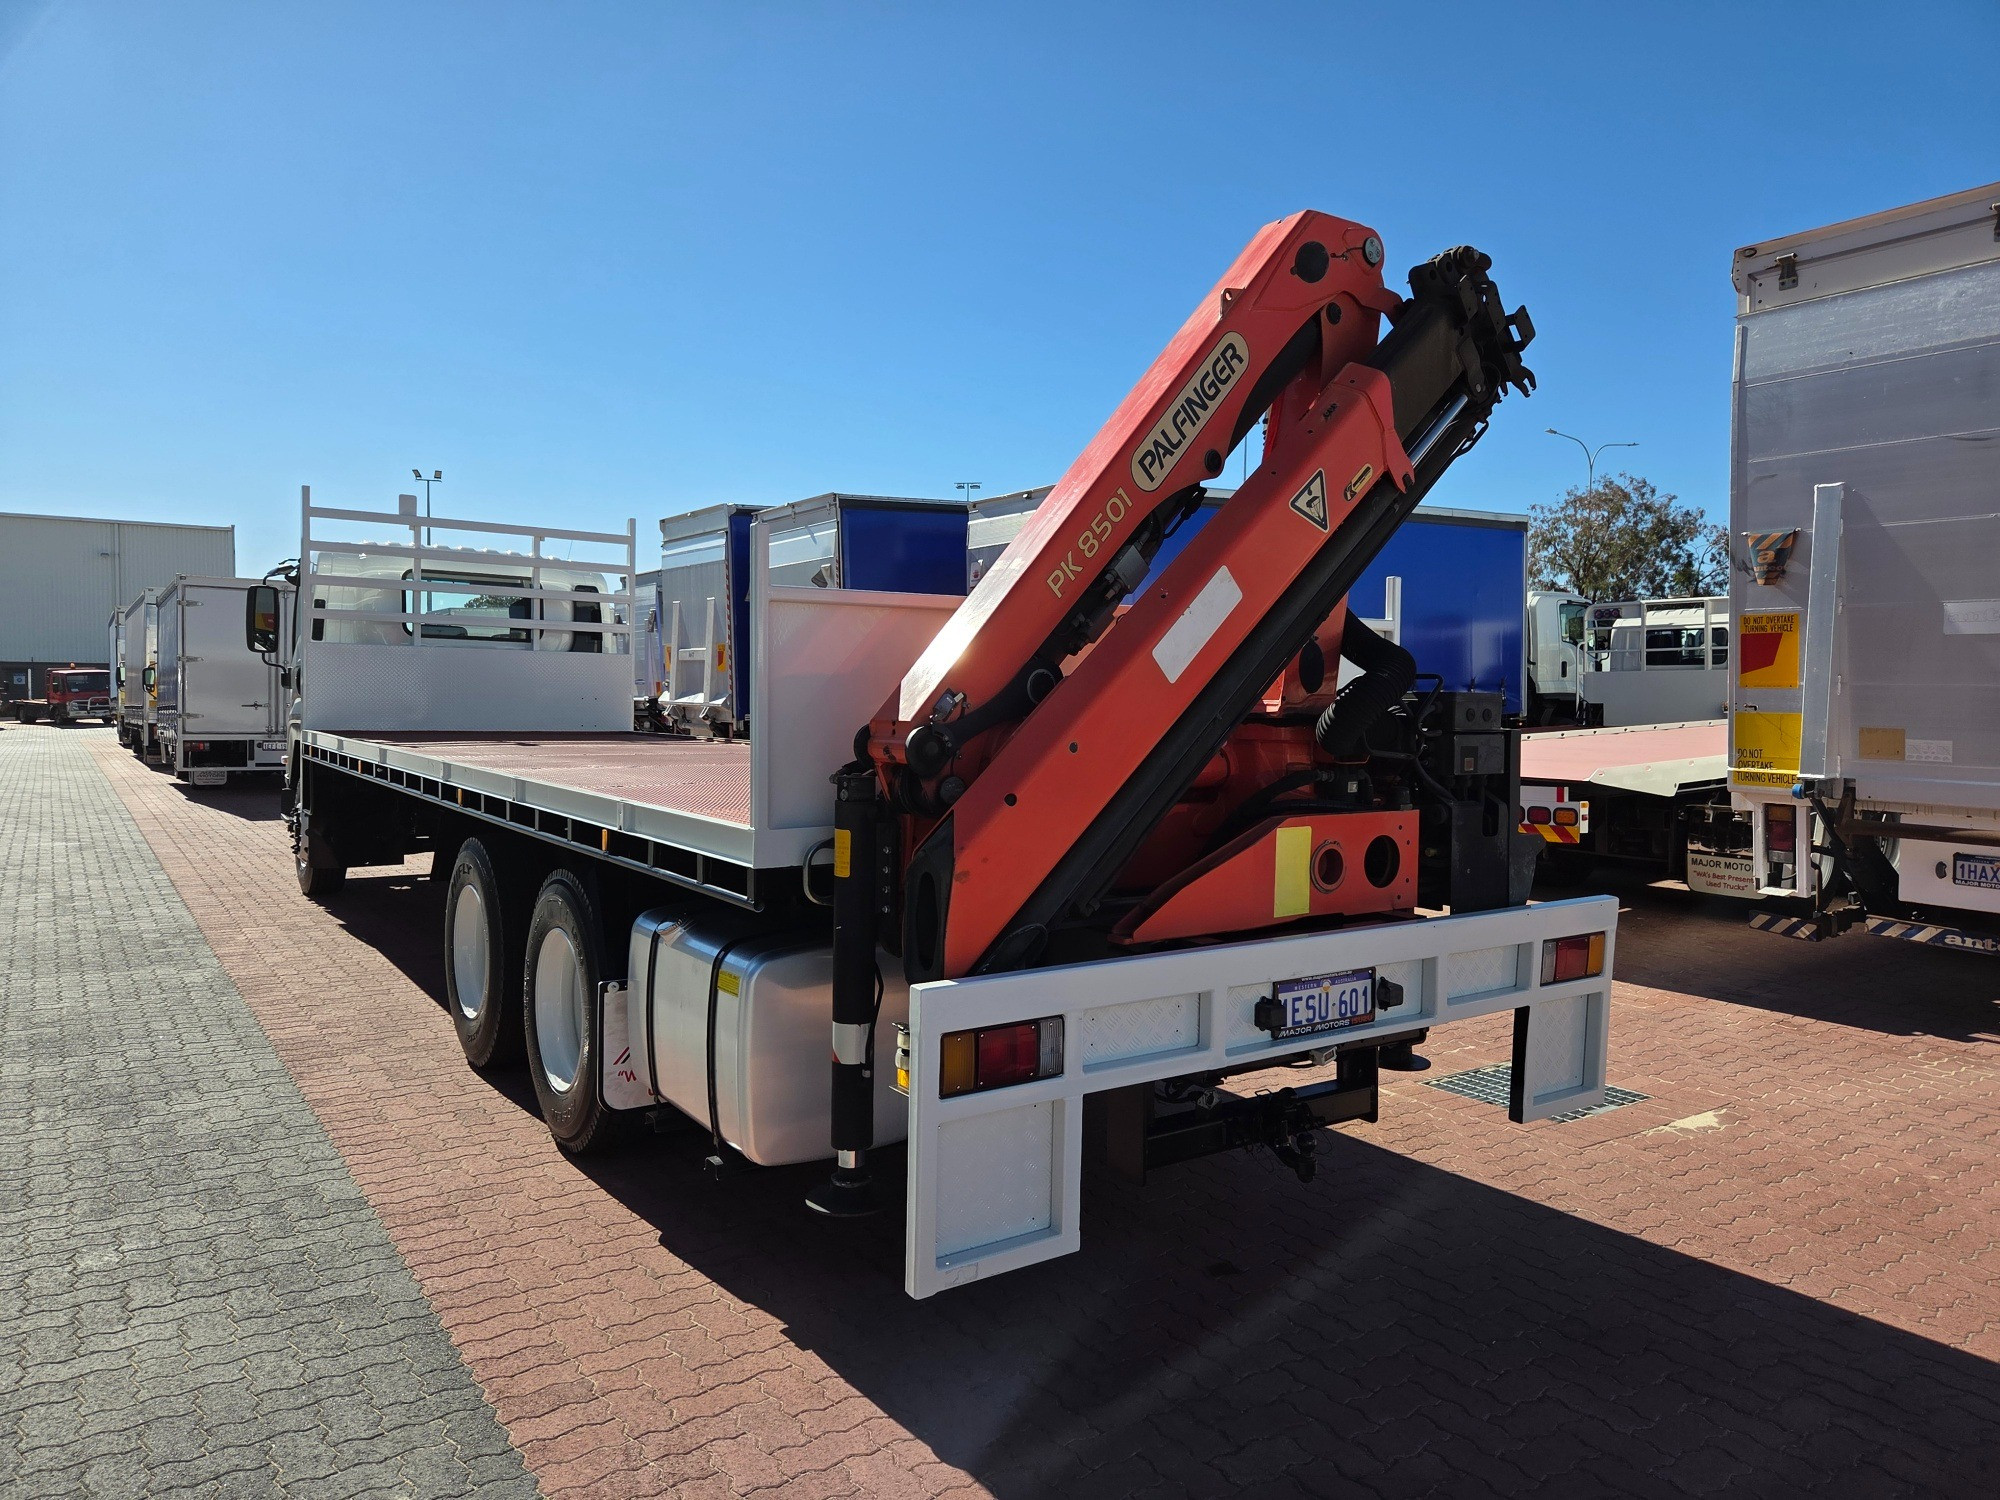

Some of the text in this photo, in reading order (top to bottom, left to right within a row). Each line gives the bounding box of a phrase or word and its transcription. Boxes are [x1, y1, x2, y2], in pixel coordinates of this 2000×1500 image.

[1137, 342, 1245, 483] PALFINGER
[1046, 487, 1133, 598] PK 8501
[1743, 614, 1795, 625] DO NOT OVERTAKE
[1745, 623, 1794, 633] TURNING VEHICLE
[1737, 748, 1763, 759] DO NOT
[1737, 760, 1774, 770] OVERTAKE
[1736, 771, 1797, 784] TURNING VEHICLE
[1691, 857, 1753, 872] MAJOR MOTO
[1712, 872, 1726, 880] Best
[1706, 880, 1722, 888] Used
[1955, 879, 1979, 887] MAJOR
[1944, 934, 2000, 952] ant
[1278, 1026, 1312, 1038] MAJOR
[1314, 1019, 1350, 1032] MOTORS
